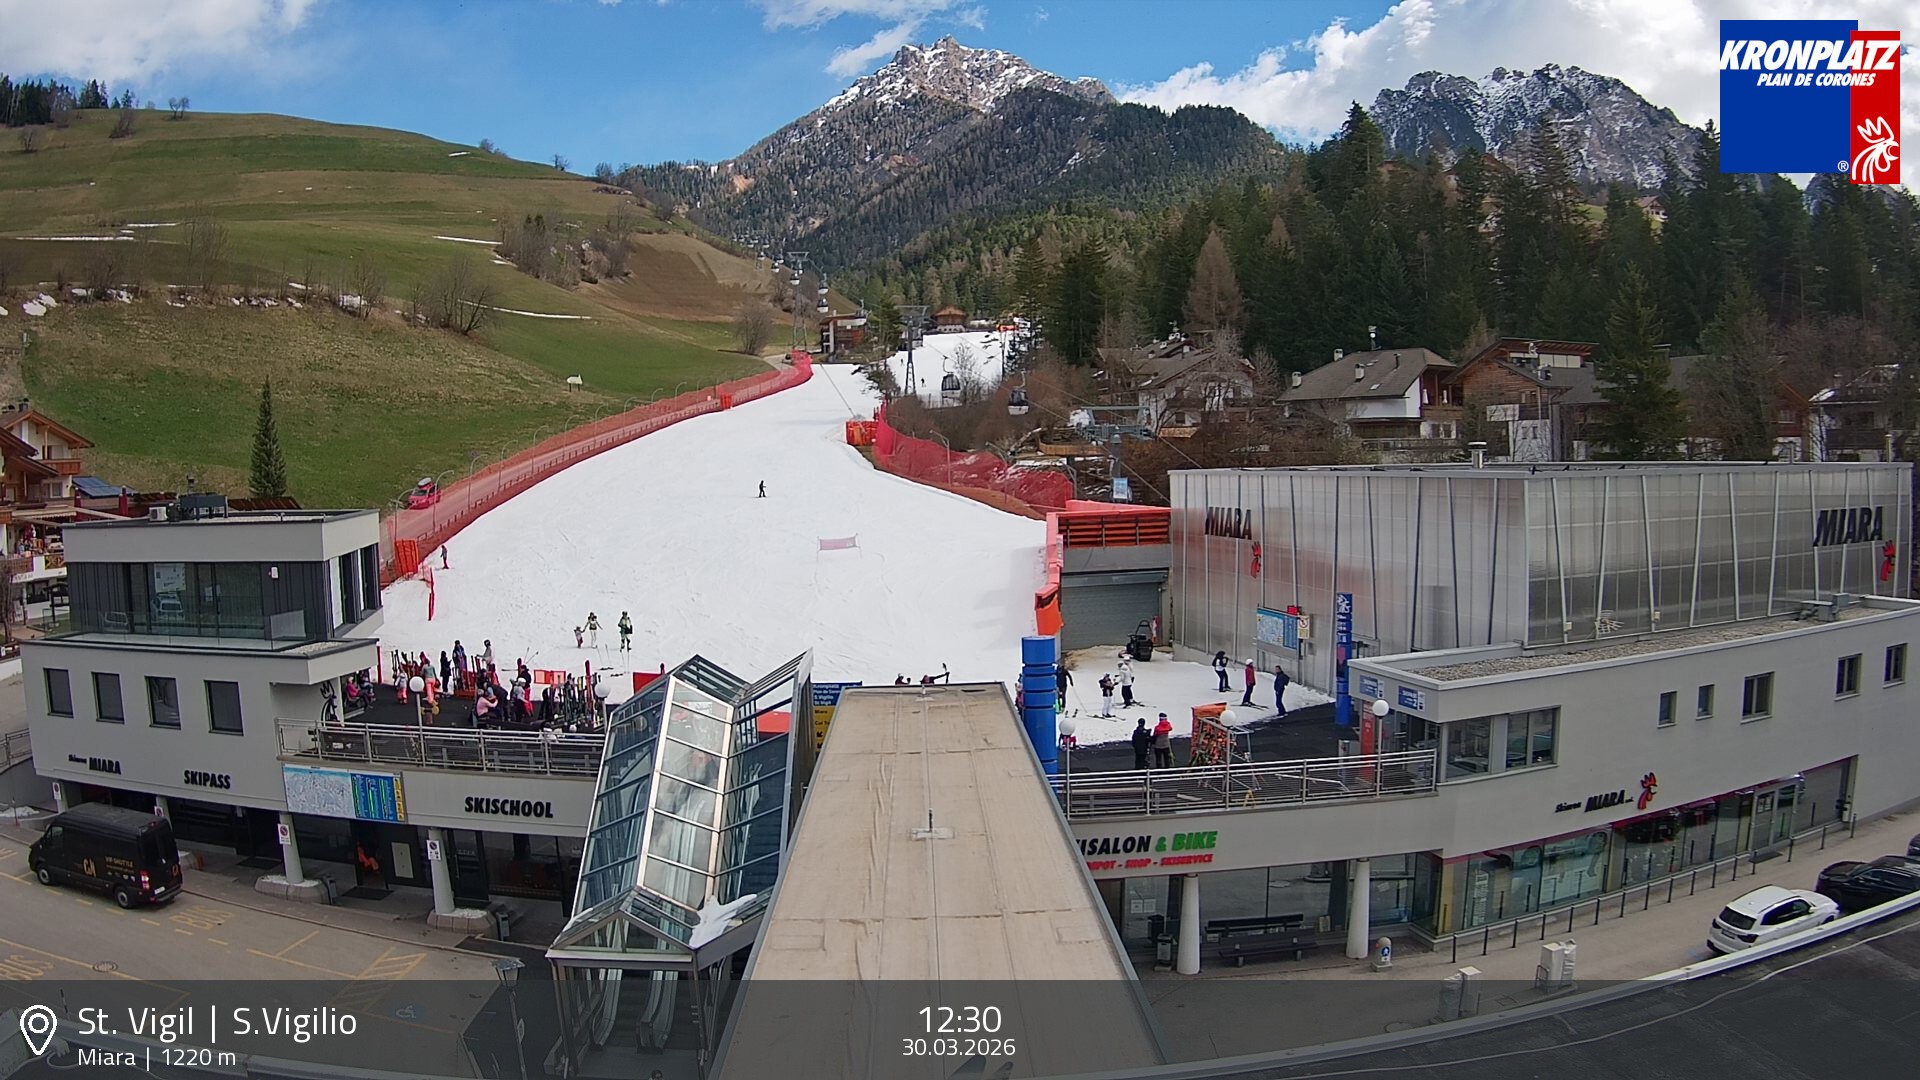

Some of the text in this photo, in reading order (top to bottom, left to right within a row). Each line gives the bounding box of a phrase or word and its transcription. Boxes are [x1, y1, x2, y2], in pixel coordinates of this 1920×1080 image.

[1204, 506, 1252, 540] MIARA
[1813, 506, 1883, 547] MIARA
[89, 757, 122, 775] MIARA
[184, 770, 231, 789] SKIPASS
[465, 797, 553, 818] SKISCHOOL
[1584, 789, 1625, 812] MIARA
[1076, 830, 1218, 856] ISALON & BIKE
[1125, 858, 1152, 869] SHOP
[1160, 854, 1214, 866] SKISERVICE
